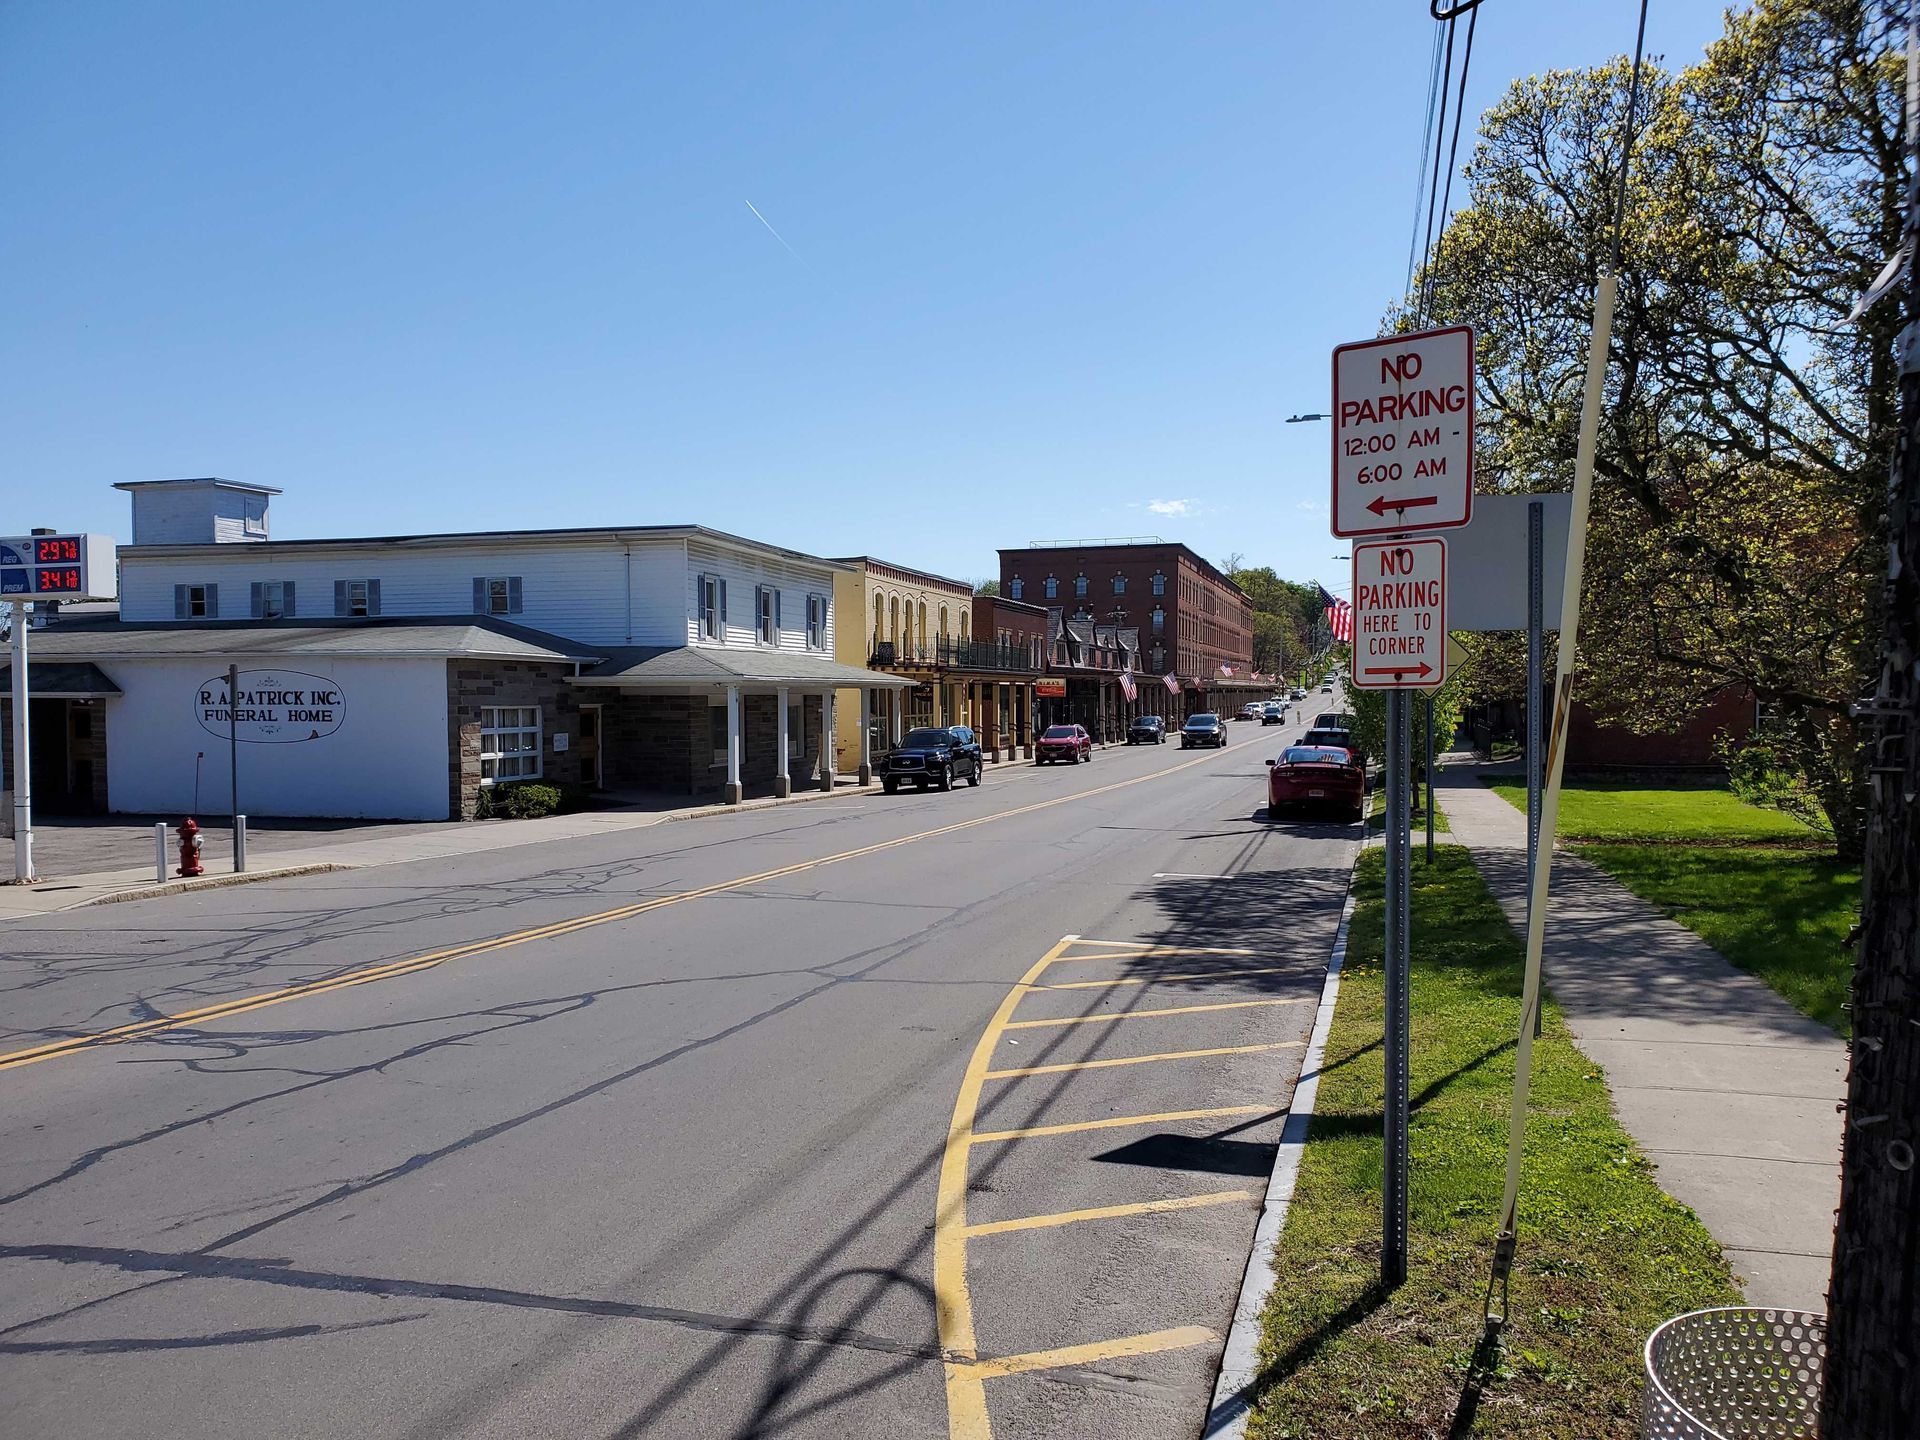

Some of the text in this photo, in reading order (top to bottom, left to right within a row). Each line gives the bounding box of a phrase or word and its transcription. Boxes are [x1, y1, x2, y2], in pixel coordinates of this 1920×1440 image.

[1381, 353, 1422, 384] NO
[1341, 385, 1465, 428] PARKING
[1344, 433, 1396, 457] 12:00
[1407, 427, 1440, 449] AM
[1357, 457, 1446, 485] 6:00 AM
[2, 555, 18, 564] REG
[1380, 548, 1414, 577] NO
[3, 583, 24, 592] PREM
[1359, 580, 1439, 611] PARKING
[1363, 612, 1431, 633] HERE TO
[1369, 636, 1425, 655] CORNER
[200, 691, 215, 705] R.
[237, 691, 305, 706] PATRICK
[310, 691, 341, 706] INC.
[204, 709, 333, 722] FUNERAL HOME
